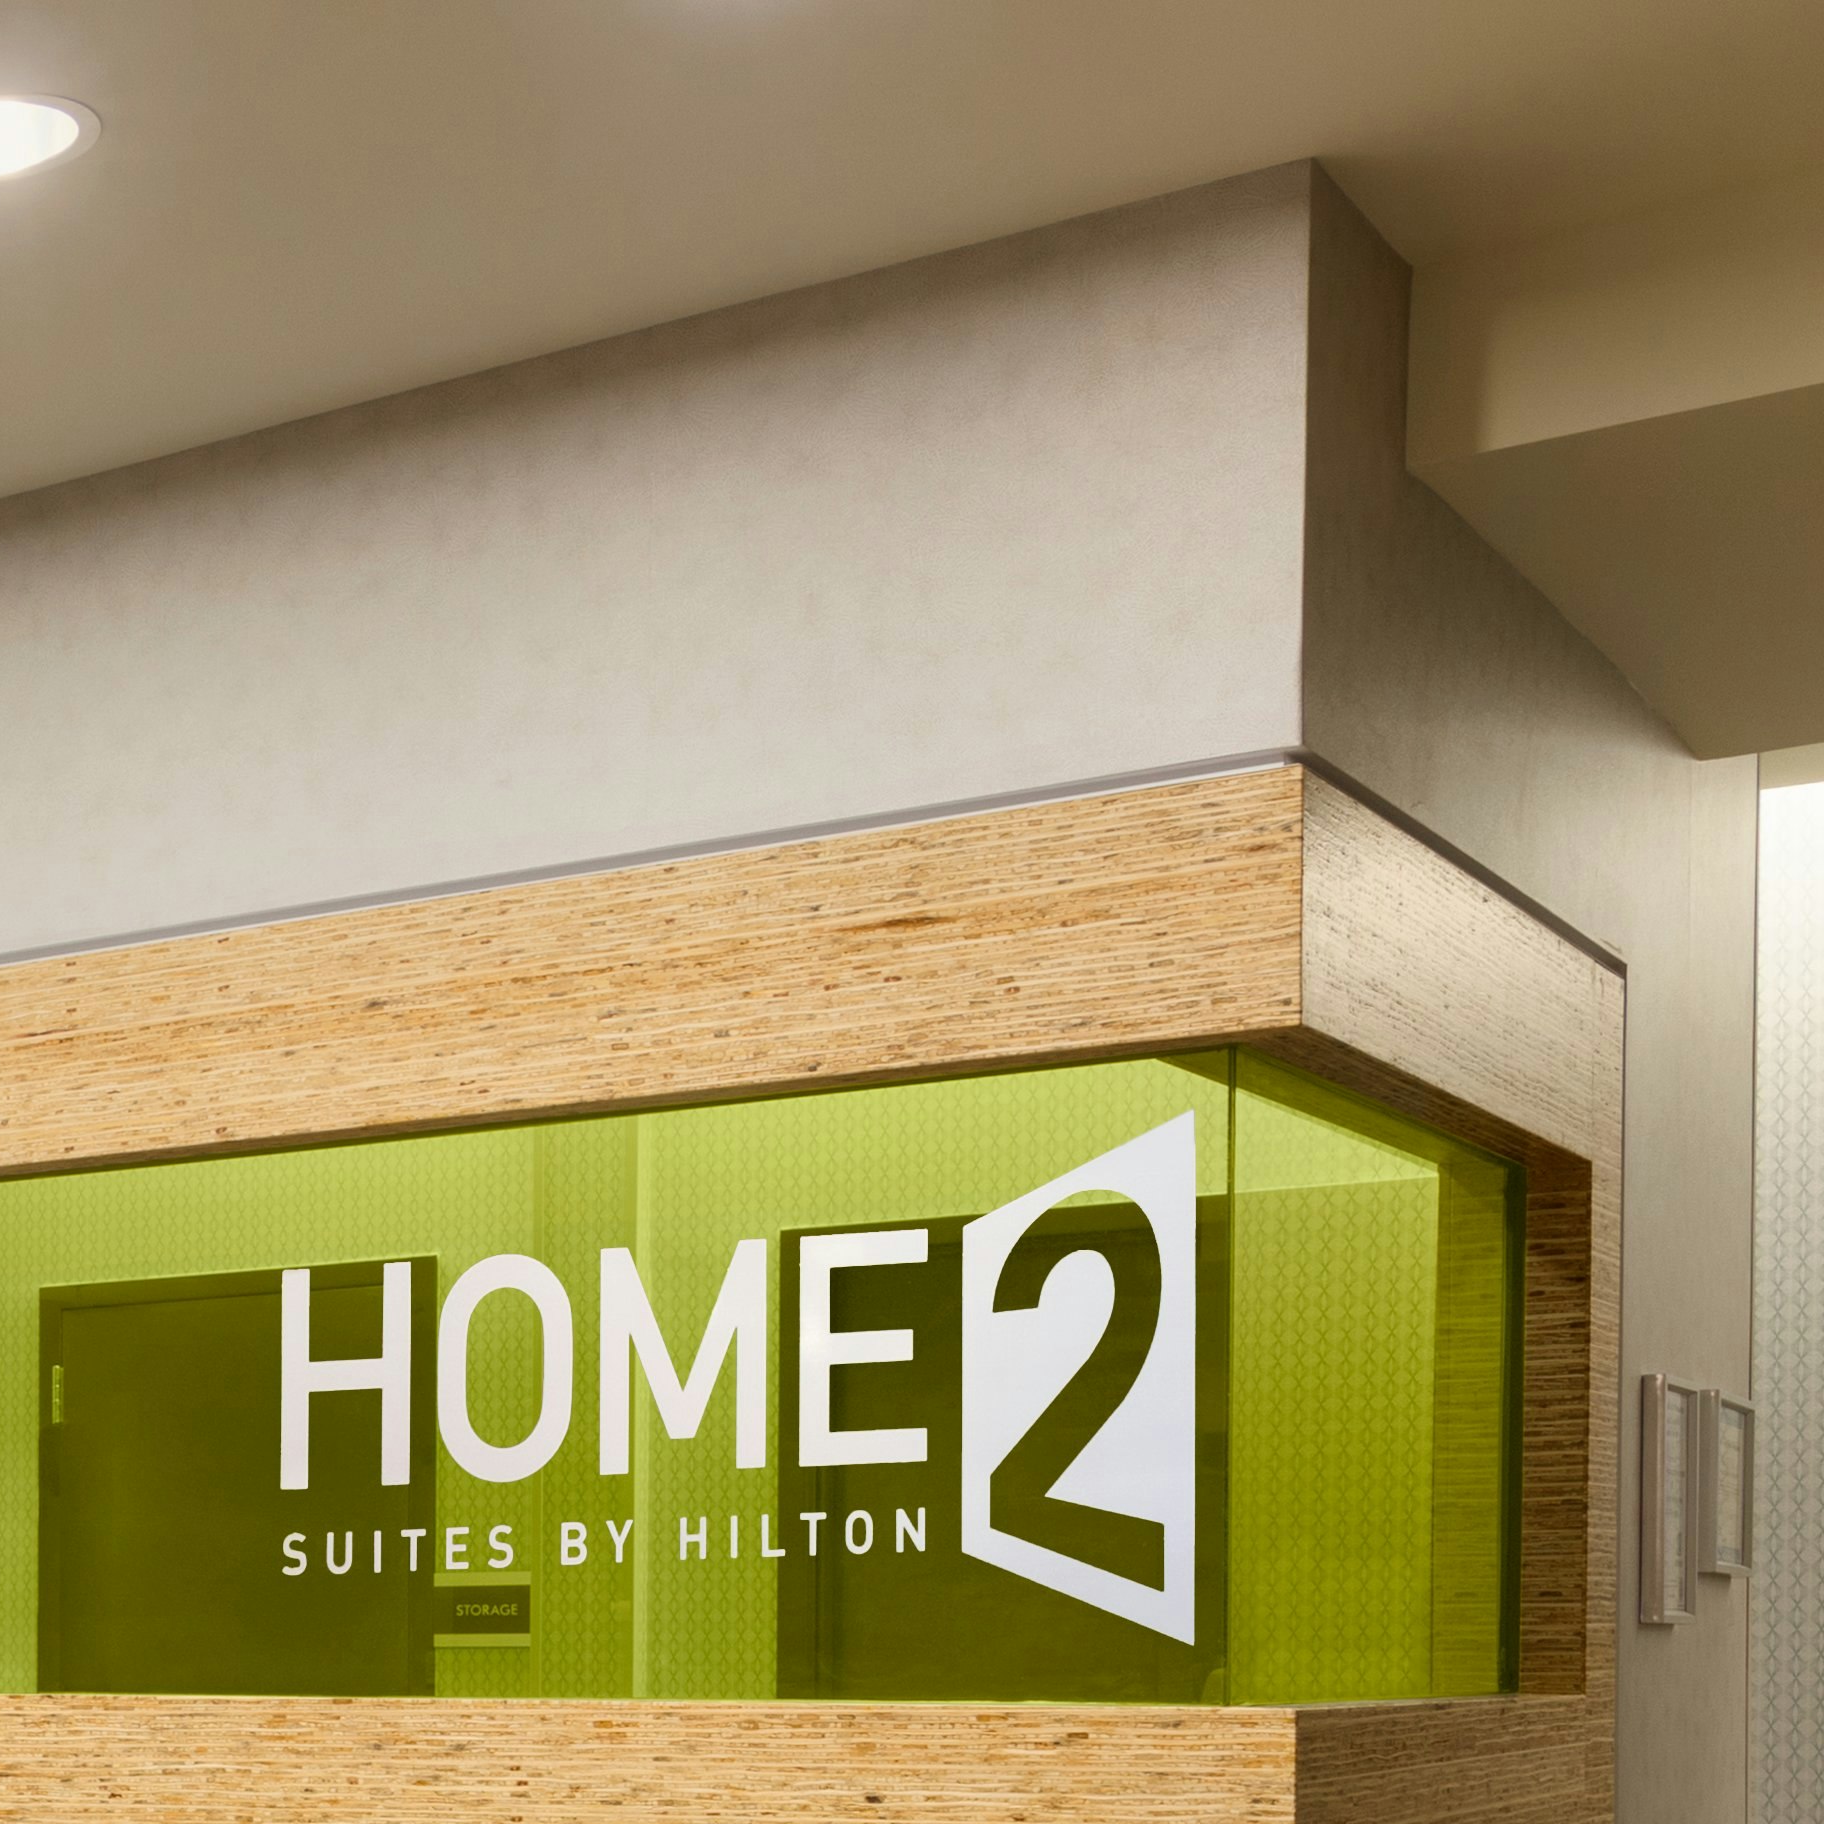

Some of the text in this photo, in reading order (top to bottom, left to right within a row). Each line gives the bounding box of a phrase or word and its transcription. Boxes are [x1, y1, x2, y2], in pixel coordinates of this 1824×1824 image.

[282, 1507, 927, 1576] SUITES BY HILTON
[455, 1603, 518, 1617] STORAGE
